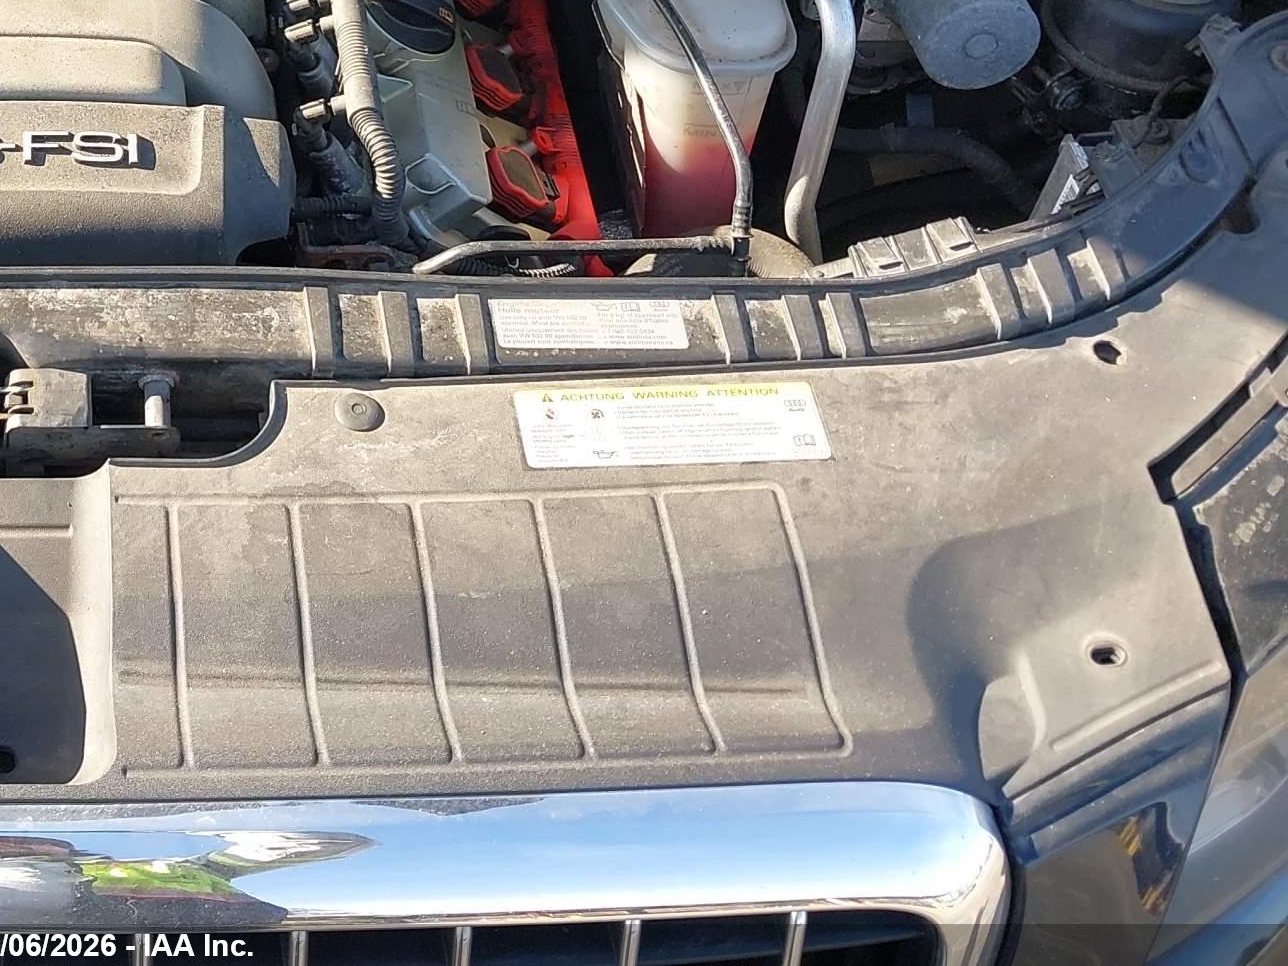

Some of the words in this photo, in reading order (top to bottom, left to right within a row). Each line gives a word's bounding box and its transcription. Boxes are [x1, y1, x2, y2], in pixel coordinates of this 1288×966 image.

[560, 391, 625, 402] ACHTUNG
[631, 389, 699, 400] WARNING
[705, 386, 780, 398] ATTENTION
